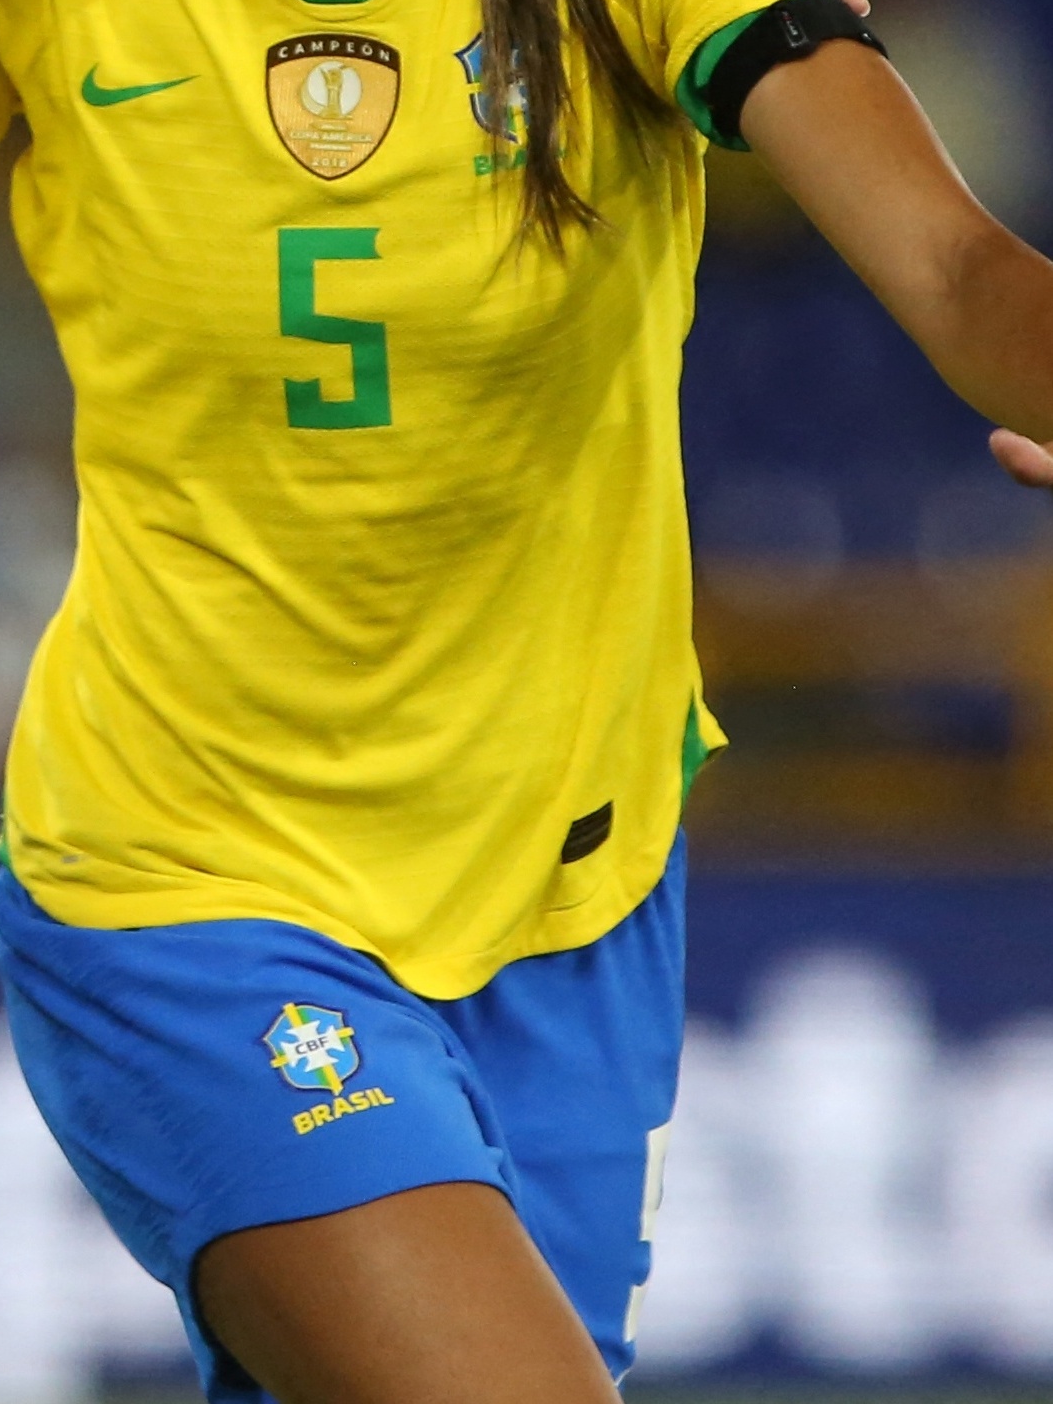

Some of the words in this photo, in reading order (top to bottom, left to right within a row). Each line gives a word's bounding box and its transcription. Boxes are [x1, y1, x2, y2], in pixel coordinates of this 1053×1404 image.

[278, 40, 390, 62] CAMPEÓN
[278, 228, 392, 429] 5
[294, 1036, 330, 1055] CBF
[292, 1087, 395, 1135] BRASIL
